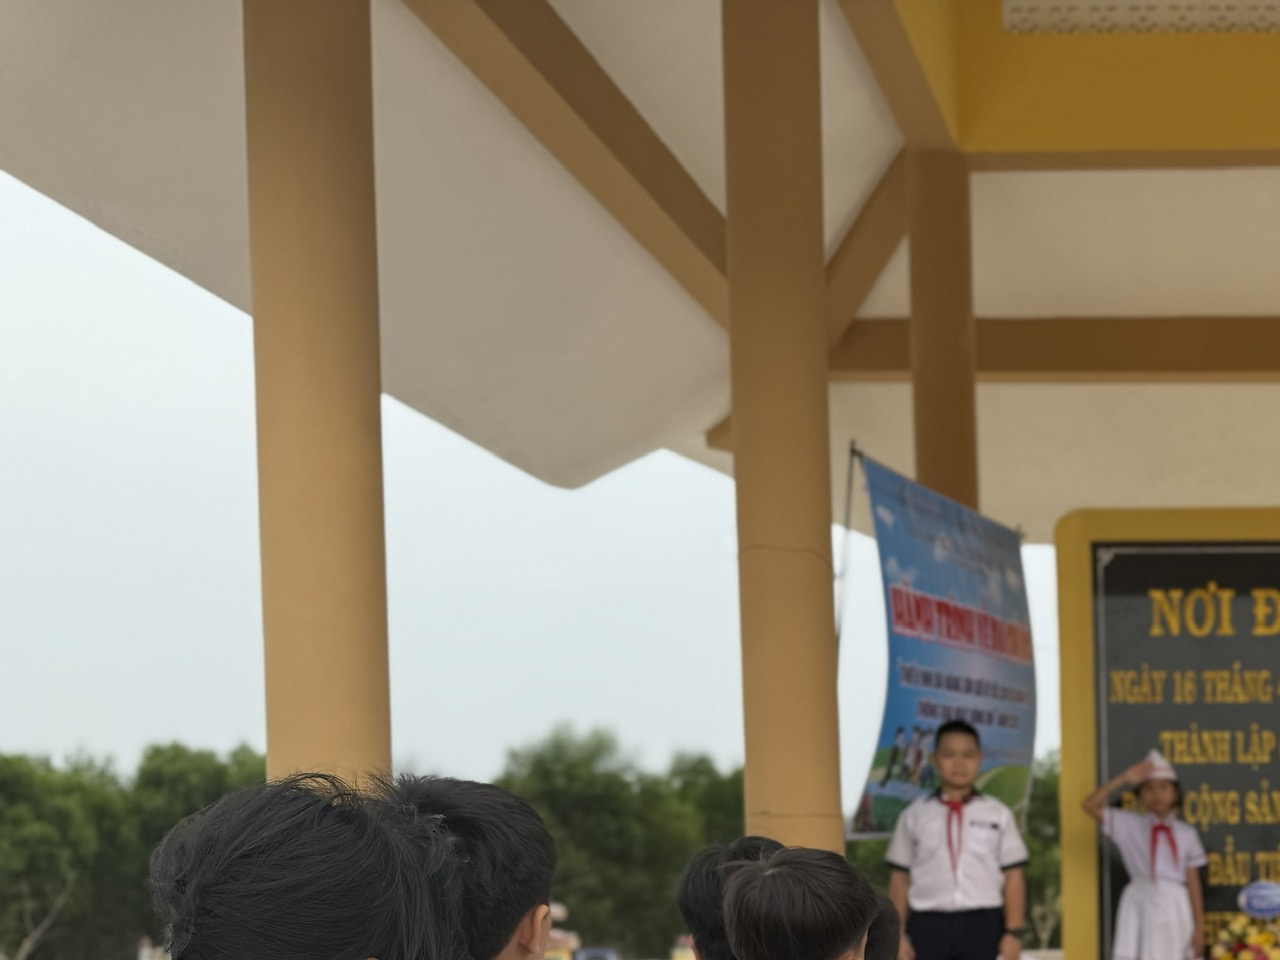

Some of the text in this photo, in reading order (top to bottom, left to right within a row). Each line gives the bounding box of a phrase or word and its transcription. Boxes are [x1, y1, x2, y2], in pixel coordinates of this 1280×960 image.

[1148, 581, 1236, 637] NƠI
[1110, 662, 1167, 704] NGÀY
[1173, 669, 1197, 704] 16
[1202, 660, 1273, 704] THÁNG
[1159, 722, 1232, 765] THÀNH
[1235, 722, 1276, 771] LẬP
[1183, 784, 1241, 832] CỘNG
[1206, 835, 1250, 886] ĐẦU
